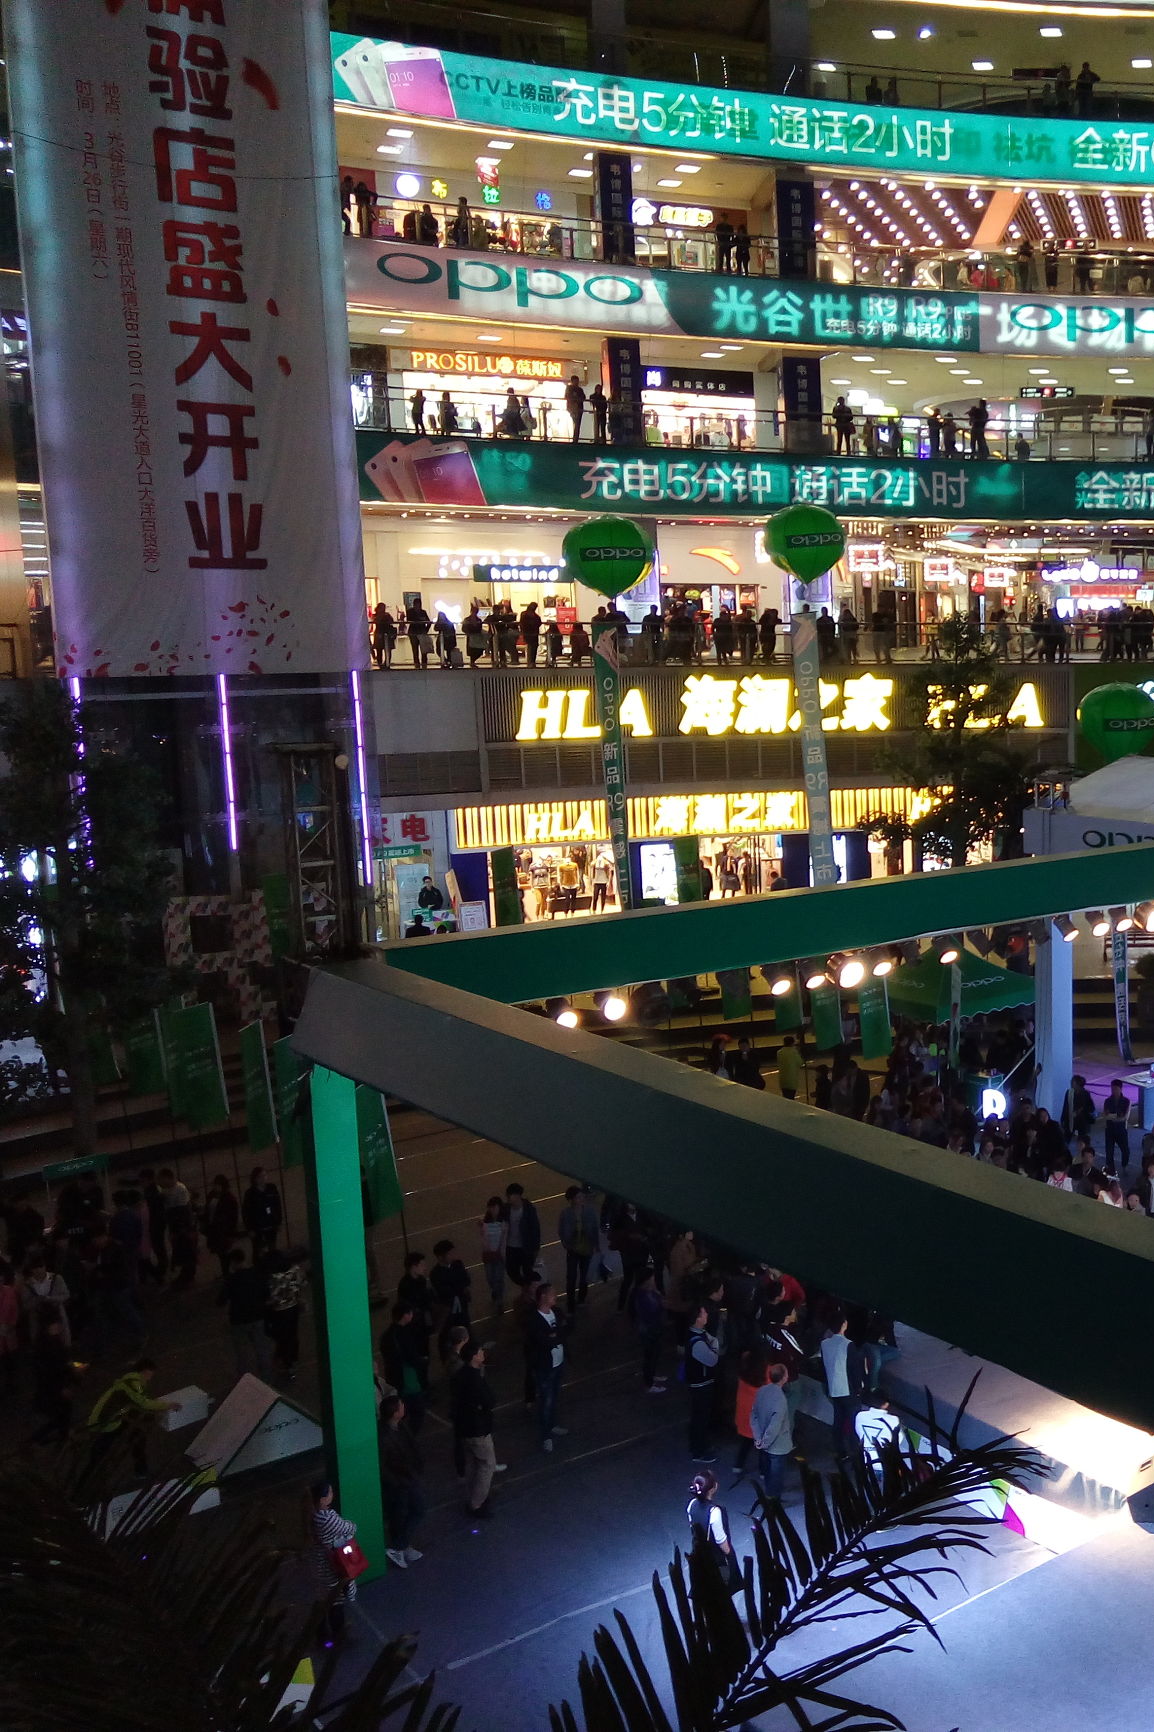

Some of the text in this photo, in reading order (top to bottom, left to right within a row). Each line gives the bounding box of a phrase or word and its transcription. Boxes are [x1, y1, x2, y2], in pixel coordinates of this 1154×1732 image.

[552, 78, 751, 143] 充电5分钟
[768, 103, 955, 161] 通话2小时
[376, 252, 643, 308] oppo
[579, 458, 772, 505] 充电5分钟
[792, 467, 969, 508] 通话2小时
[585, 547, 645, 561] oppo
[602, 676, 616, 733] OPPO
[679, 673, 894, 736] 海澜之家
[603, 743, 620, 785] 新品
